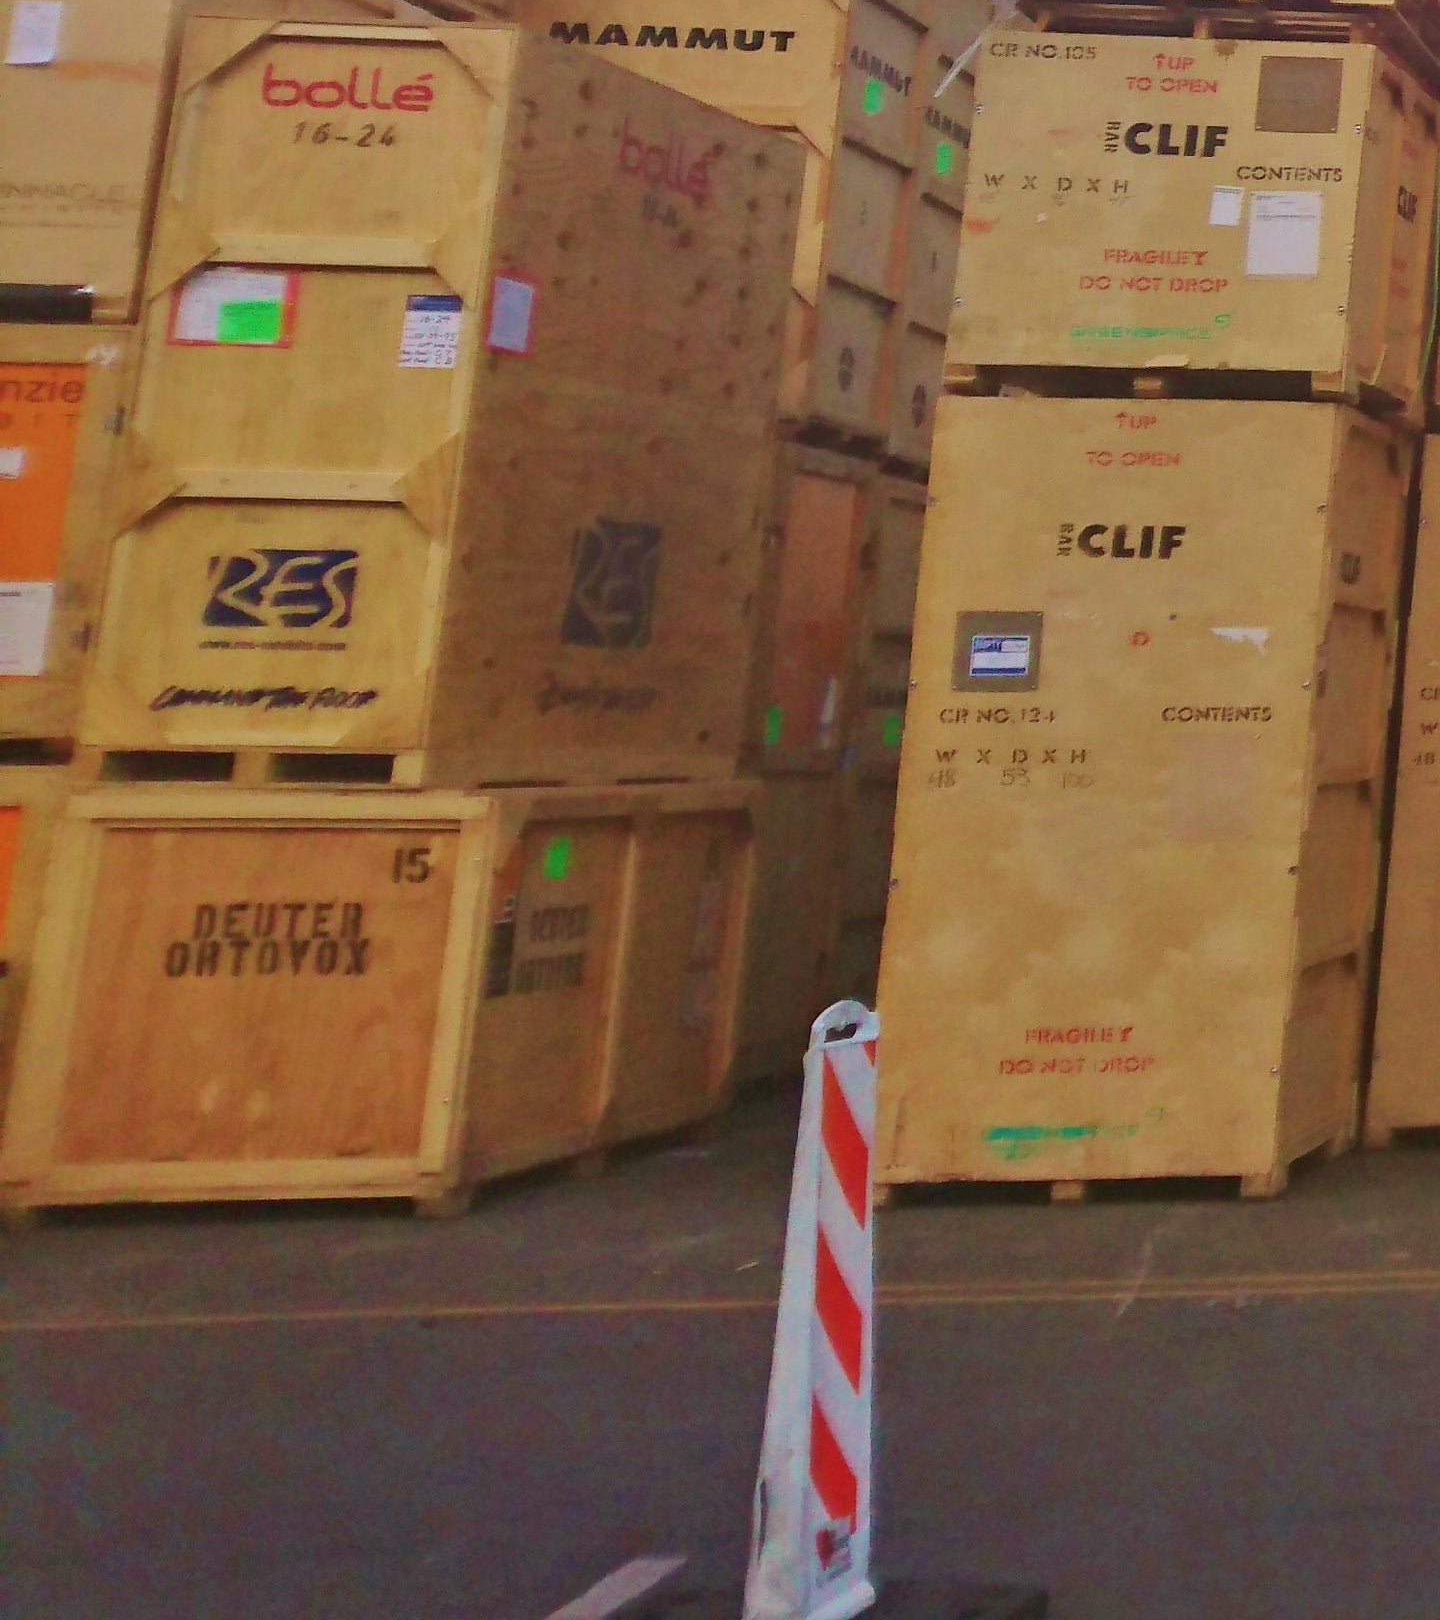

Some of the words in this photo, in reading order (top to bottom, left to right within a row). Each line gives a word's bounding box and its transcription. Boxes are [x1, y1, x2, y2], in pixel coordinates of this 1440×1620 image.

[549, 21, 796, 52] MAMMUT
[989, 43, 1018, 58] CR
[1168, 56, 1196, 71] UP
[261, 63, 434, 111] bollé
[1125, 76, 1152, 91] TO
[1160, 77, 1219, 94] OPEN
[1124, 122, 1230, 157] CLIF
[1236, 165, 1343, 182] CONTENTS
[984, 173, 1006, 189] W
[1021, 175, 1038, 190] X
[1057, 177, 1073, 192] D
[1086, 178, 1102, 193] X
[1112, 180, 1129, 194] H
[1078, 275, 1112, 291] DO
[1120, 277, 1162, 293] NOT
[1169, 277, 1229, 294] DROP
[1129, 413, 1158, 430] UP
[1086, 451, 1114, 467] TO
[1121, 452, 1181, 467] OPEN
[1077, 523, 1186, 559] CLIF
[939, 708, 969, 724] CR
[1161, 705, 1272, 723] CONTENTS
[935, 749, 957, 763] W
[976, 748, 992, 765] X
[1012, 749, 1029, 764] D
[1042, 748, 1057, 764] X
[1070, 749, 1087, 764] H
[391, 848, 431, 883] 15
[193, 902, 364, 941] DEUTER
[164, 938, 369, 978] ORTOVOX
[1040, 1057, 1087, 1076] NOT
